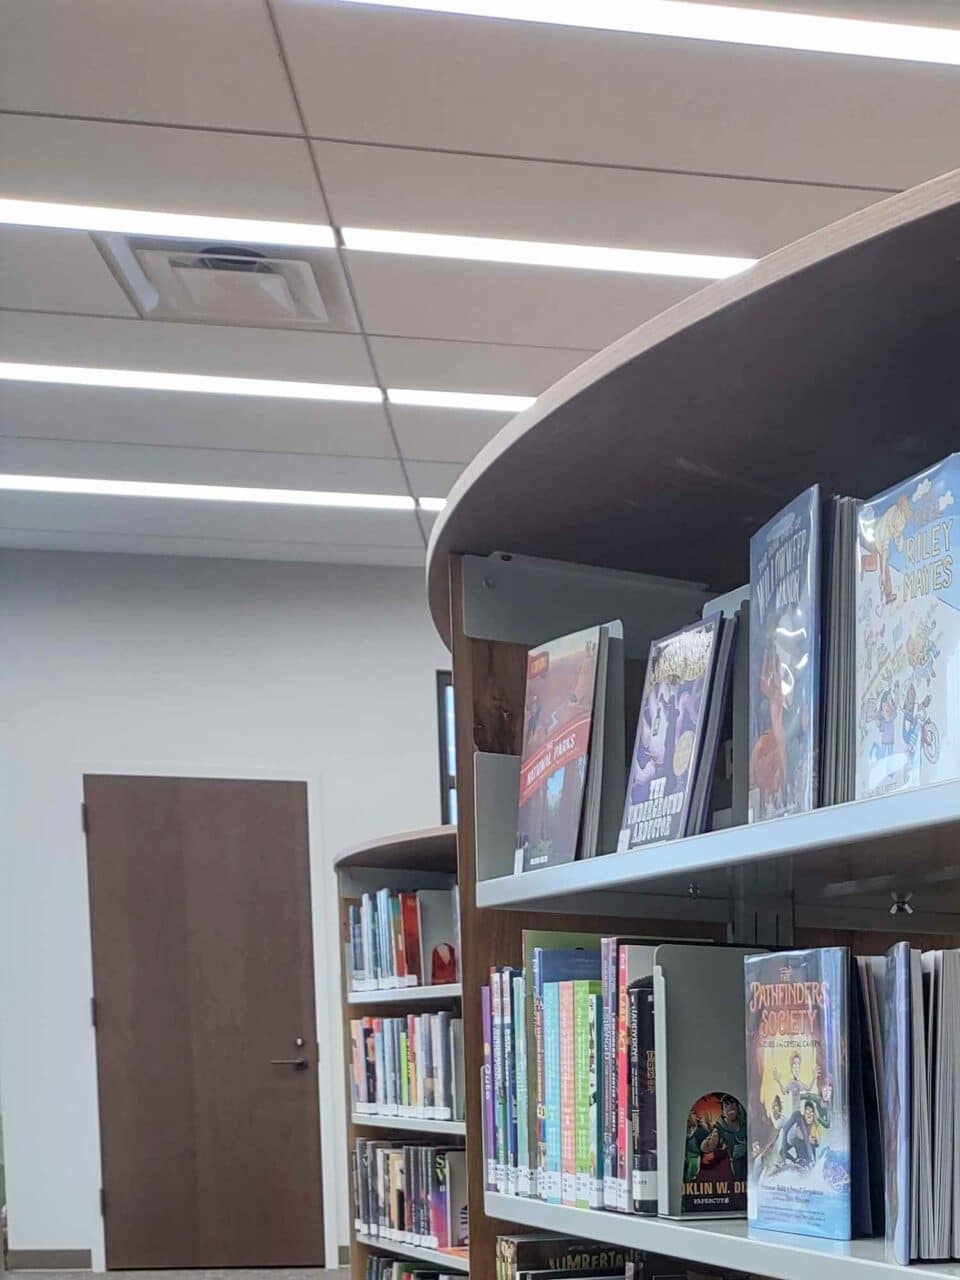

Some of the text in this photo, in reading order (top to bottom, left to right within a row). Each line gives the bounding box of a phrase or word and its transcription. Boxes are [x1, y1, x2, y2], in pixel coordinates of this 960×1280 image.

[904, 518, 953, 566] RILEY
[902, 555, 953, 602] MAYES
[526, 733, 576, 786] NATIONAL PARKS
[649, 777, 667, 800] THE
[750, 982, 829, 1013] PATHFINDERS
[759, 1010, 817, 1037] SOCIETY
[619, 1030, 627, 1054] ACT
[682, 1180, 747, 1196] KLIN W. DI
